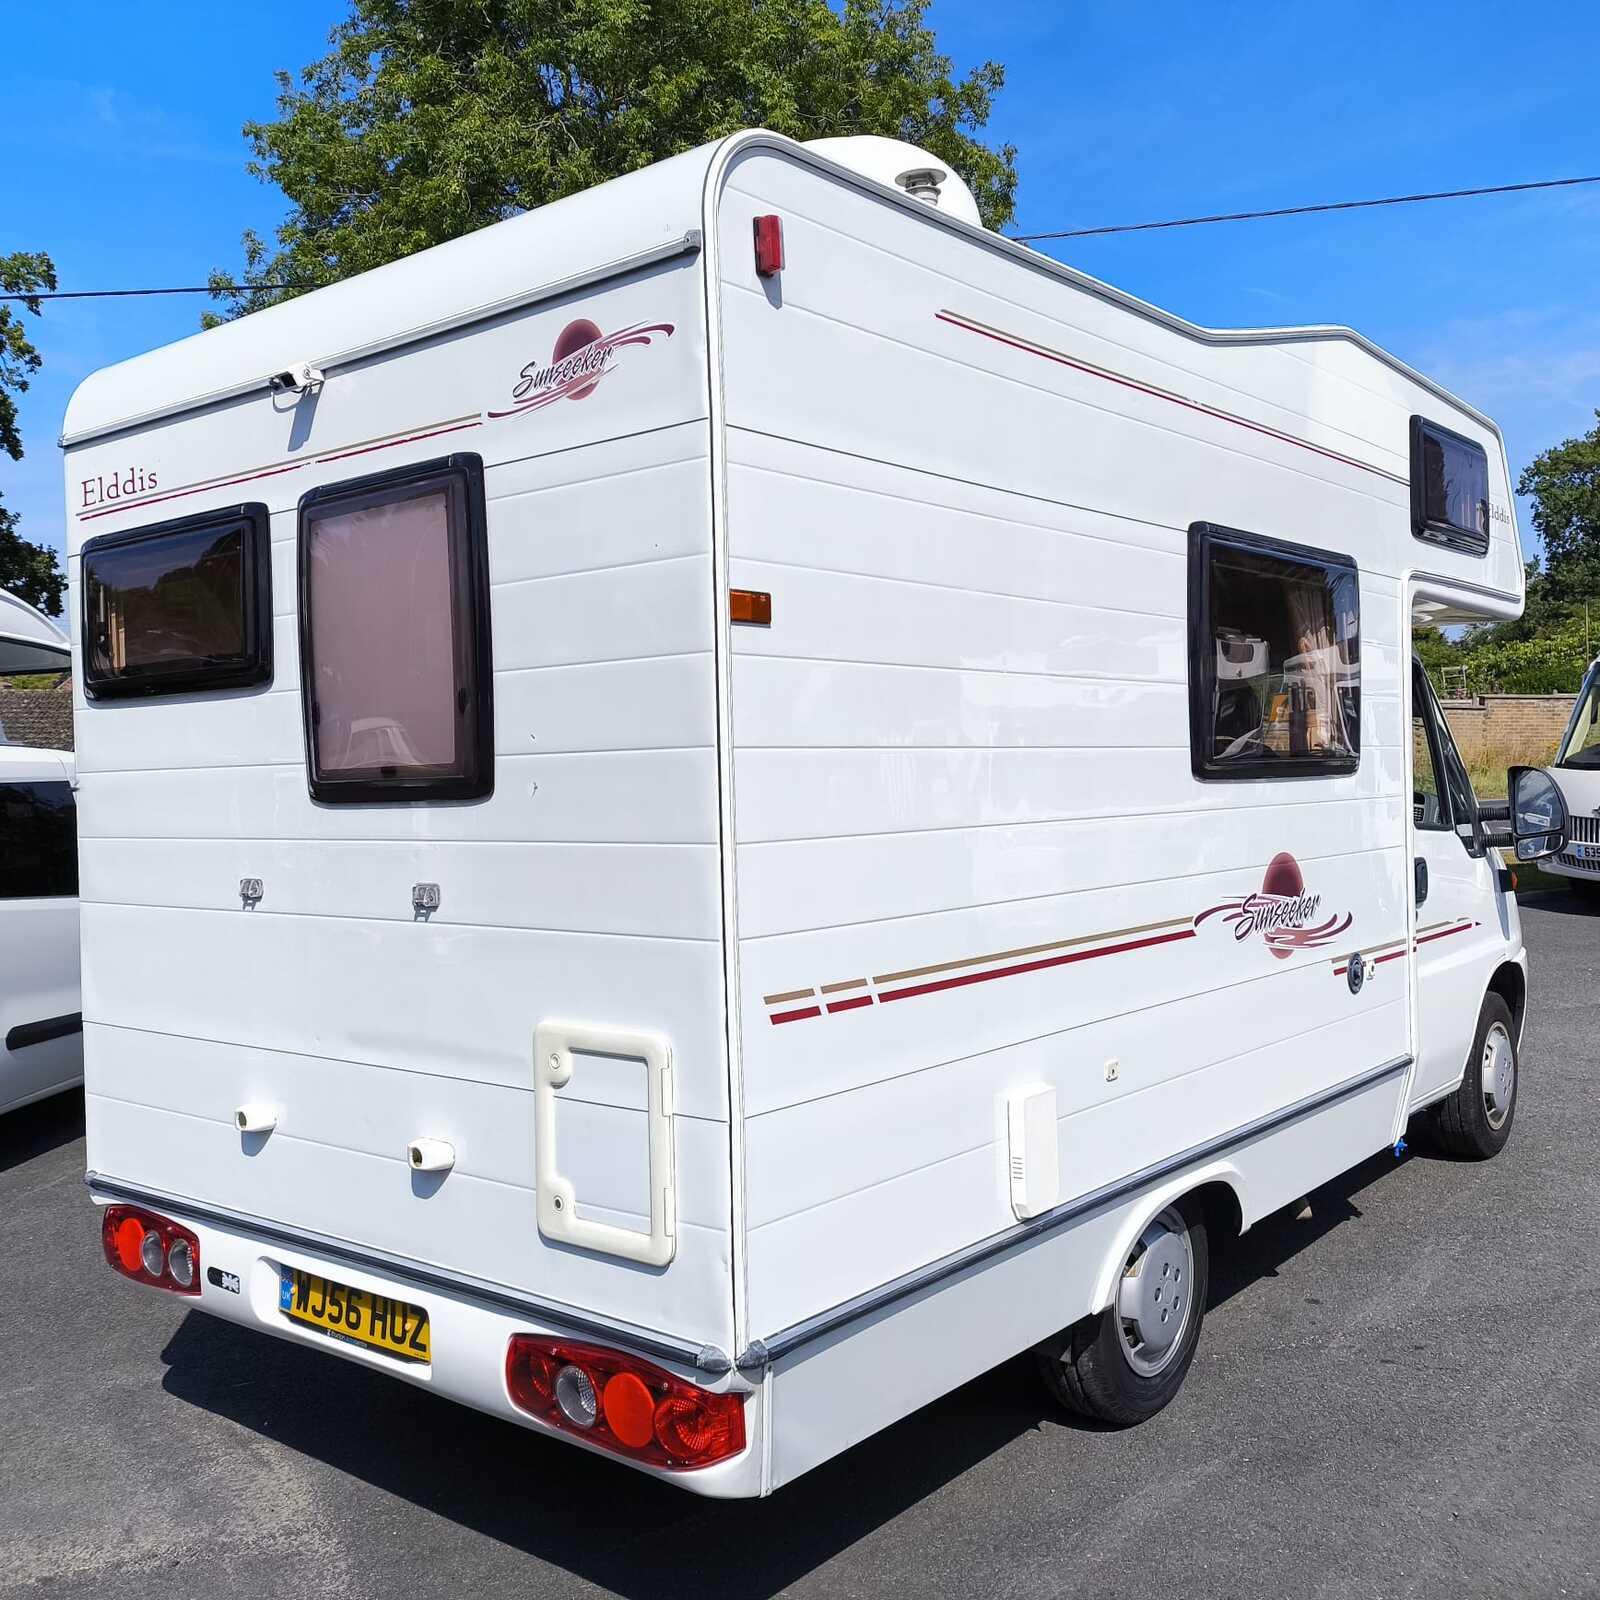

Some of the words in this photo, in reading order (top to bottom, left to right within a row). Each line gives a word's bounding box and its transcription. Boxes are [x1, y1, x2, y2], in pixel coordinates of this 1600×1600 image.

[512, 344, 613, 398] Sunseeker
[81, 467, 158, 507] Elddis
[1234, 888, 1320, 941] Sunseeker
[296, 1270, 361, 1330] WJ56
[370, 1295, 427, 1352] HUZ
